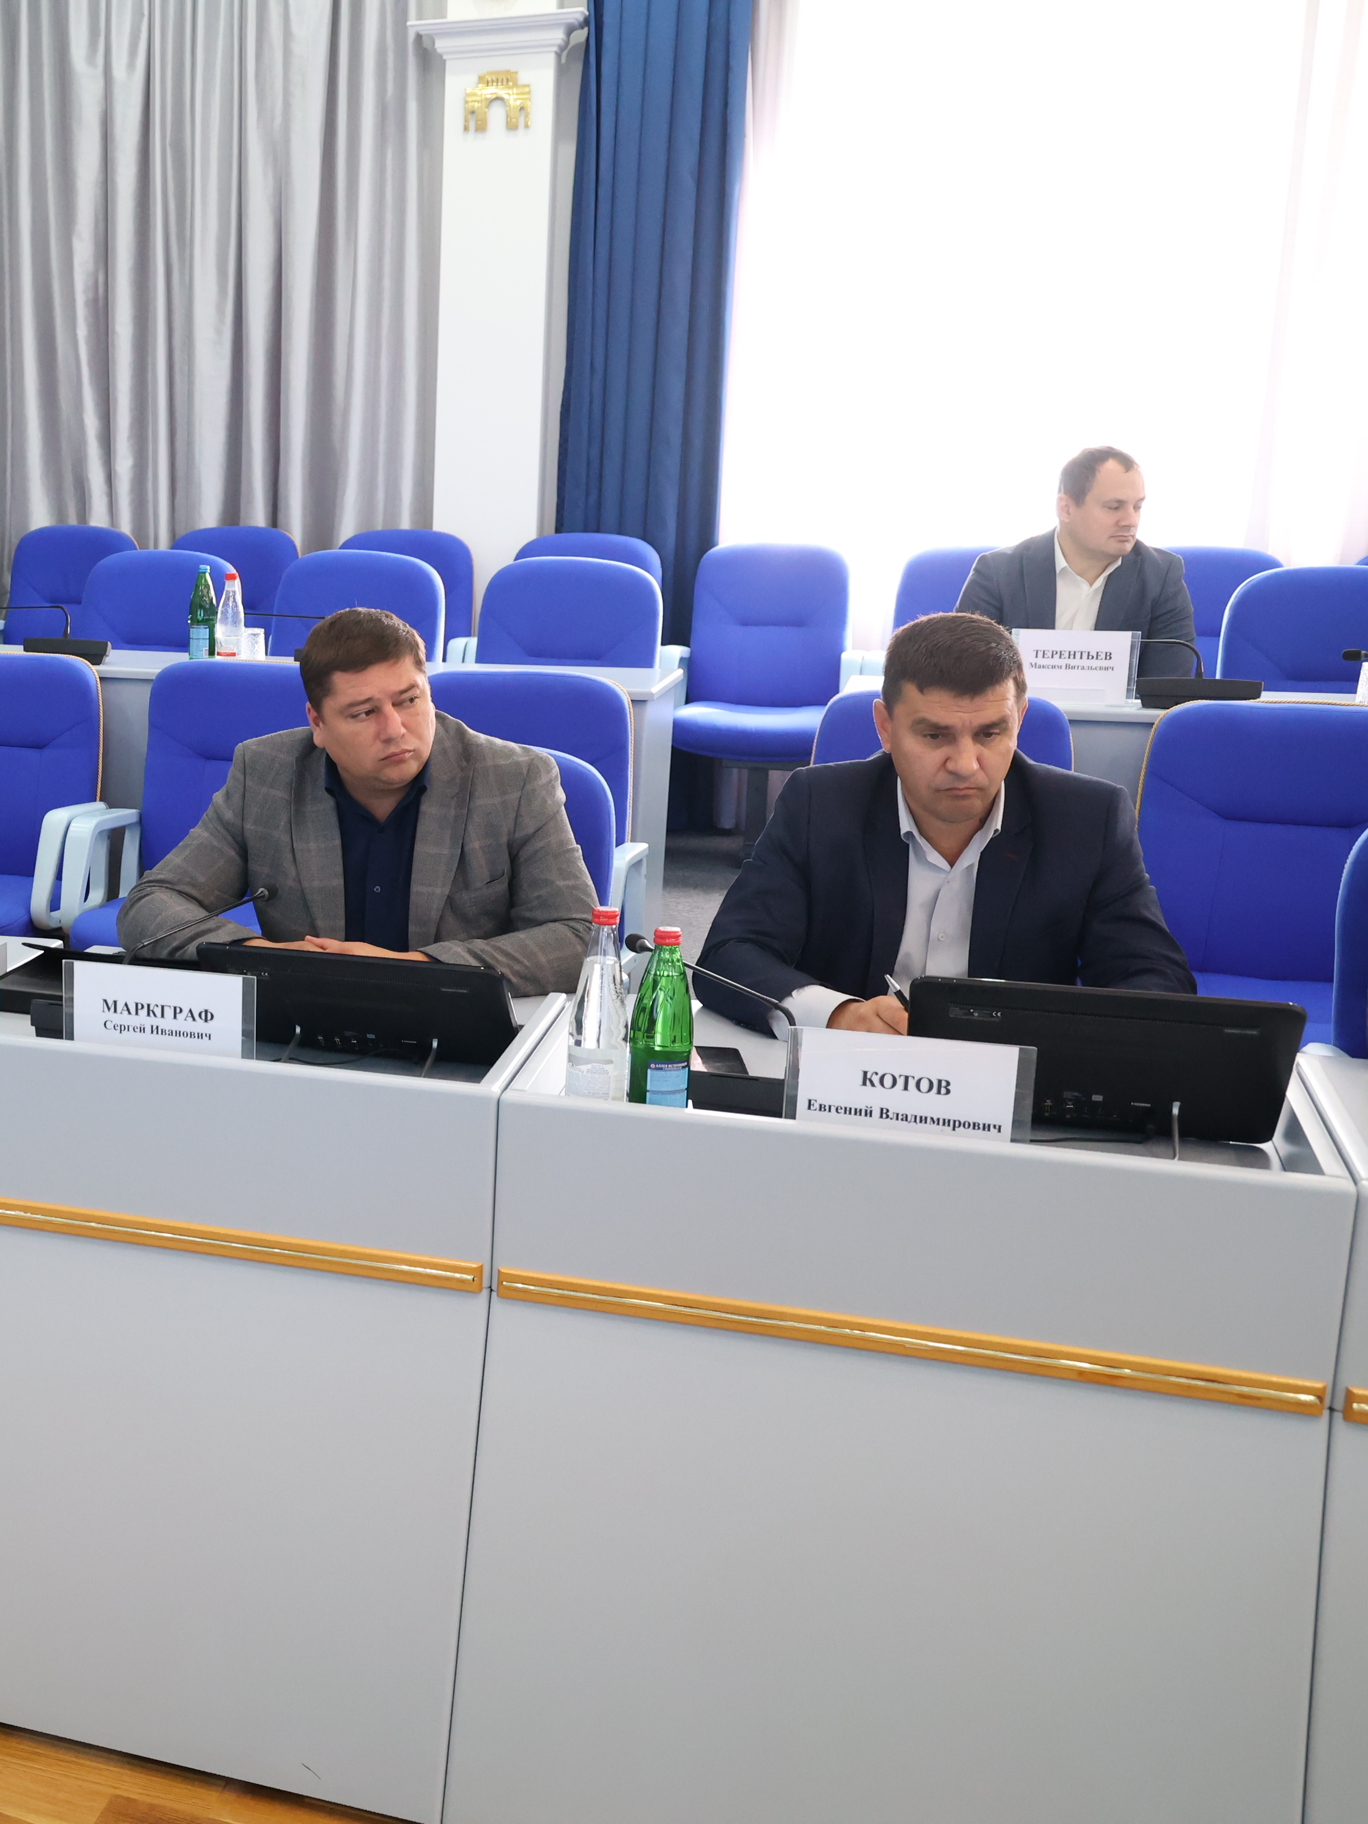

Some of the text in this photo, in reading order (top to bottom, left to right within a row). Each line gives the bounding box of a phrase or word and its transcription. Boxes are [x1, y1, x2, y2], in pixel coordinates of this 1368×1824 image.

[1029, 662, 1115, 671] Максим Витальевич
[1032, 649, 1113, 661] ТЕРЕНТЬЕВ
[101, 998, 215, 1023] МАРКГРАФ
[103, 1019, 212, 1041] Сергей Иванович
[860, 1069, 952, 1096] КОТОВ
[806, 1098, 1003, 1133] Евгений Владимирович
